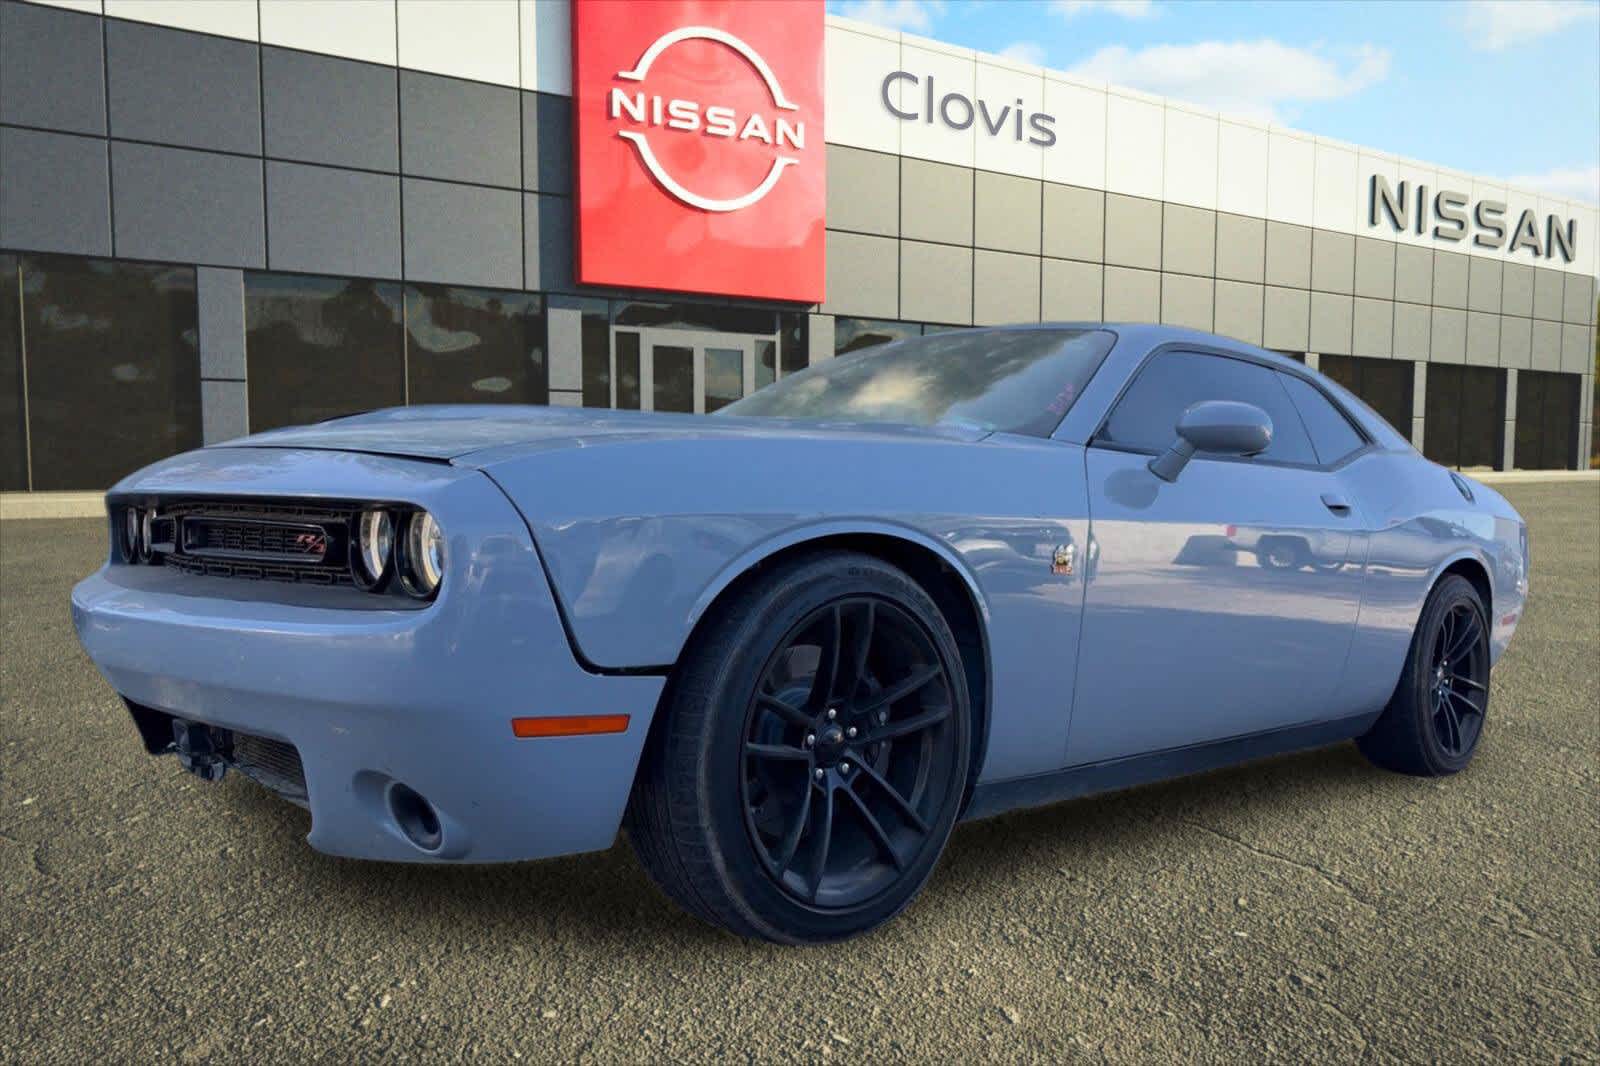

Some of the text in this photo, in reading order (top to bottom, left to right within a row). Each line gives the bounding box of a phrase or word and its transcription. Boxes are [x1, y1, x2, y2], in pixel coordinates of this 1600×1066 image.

[610, 87, 806, 150] NISSAN
[881, 71, 1057, 148] Clovis
[1369, 174, 1577, 262] NISSAN
